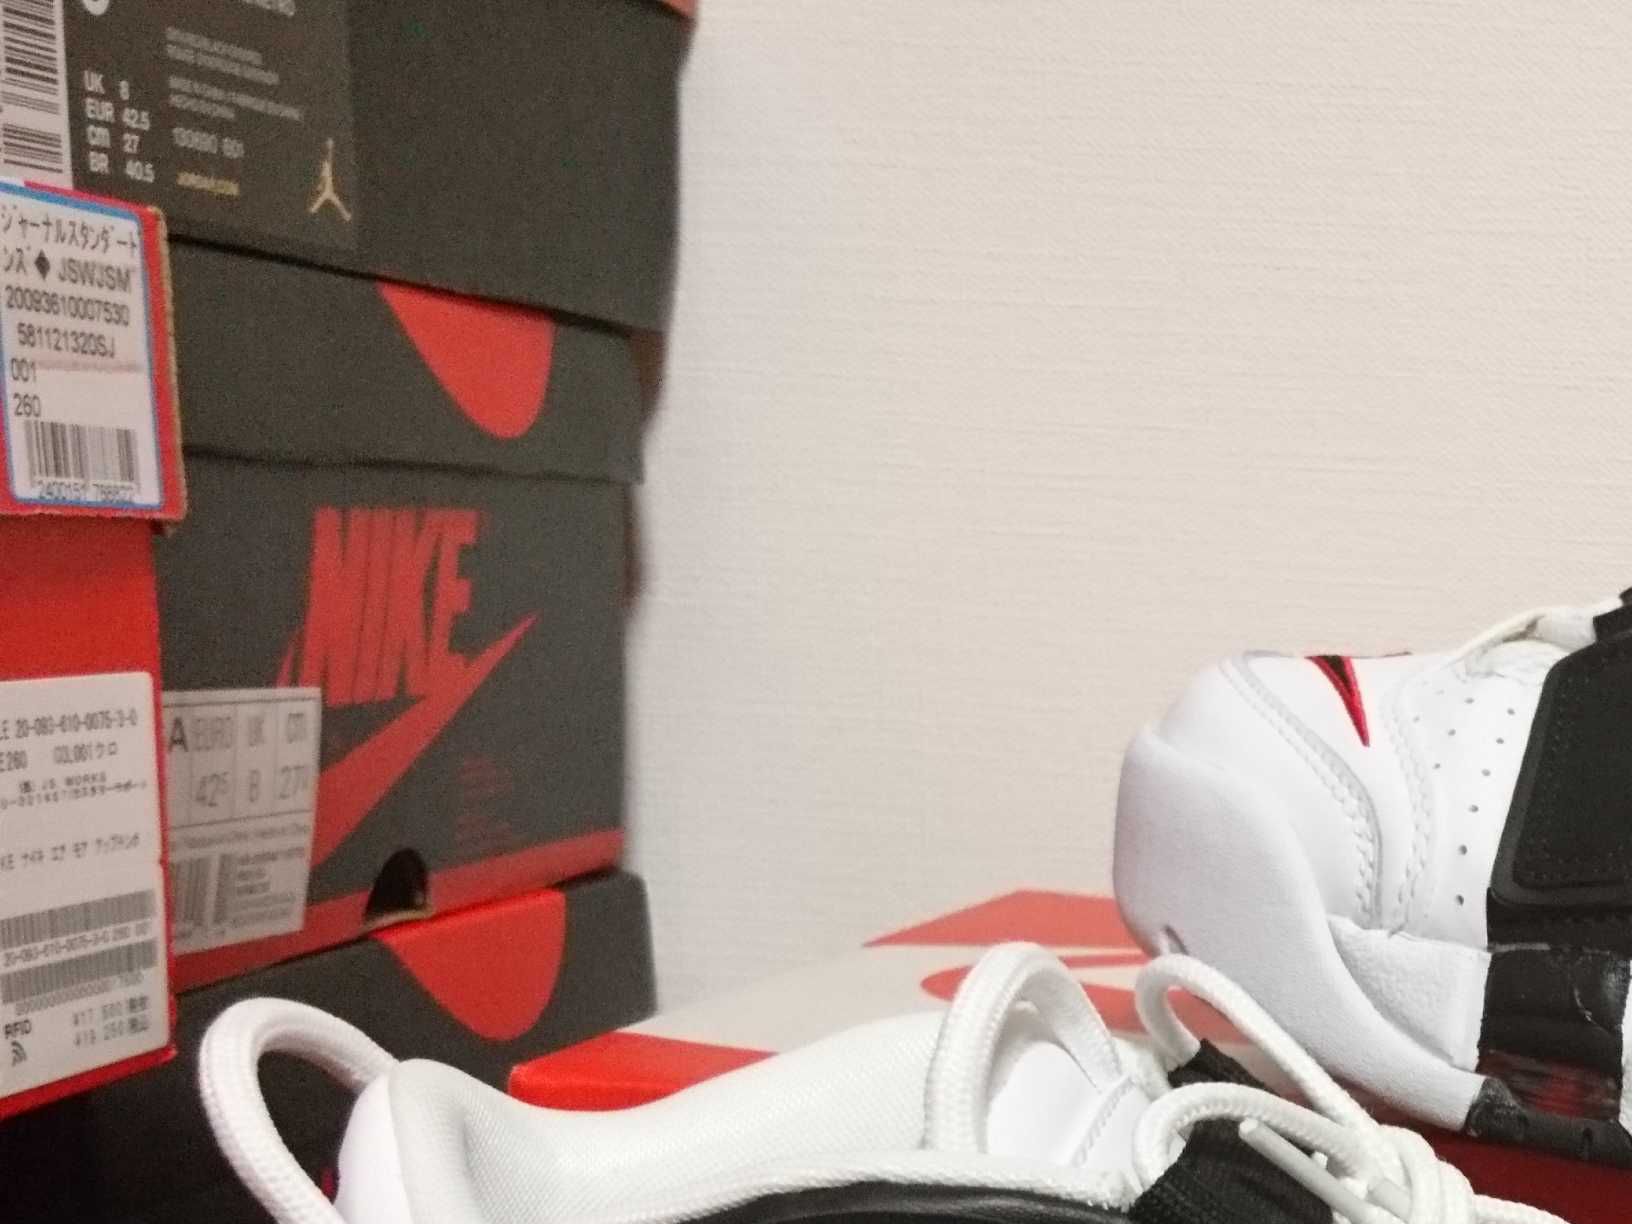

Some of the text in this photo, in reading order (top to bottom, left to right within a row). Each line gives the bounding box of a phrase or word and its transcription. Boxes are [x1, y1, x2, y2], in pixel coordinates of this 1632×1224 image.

[83, 70, 106, 95] UK
[84, 97, 115, 123] EUR
[122, 133, 140, 154] 27
[10, 356, 38, 384] 001
[13, 392, 42, 418] 260
[302, 506, 482, 707] NIKE
[4, 1018, 32, 1040] RFID
